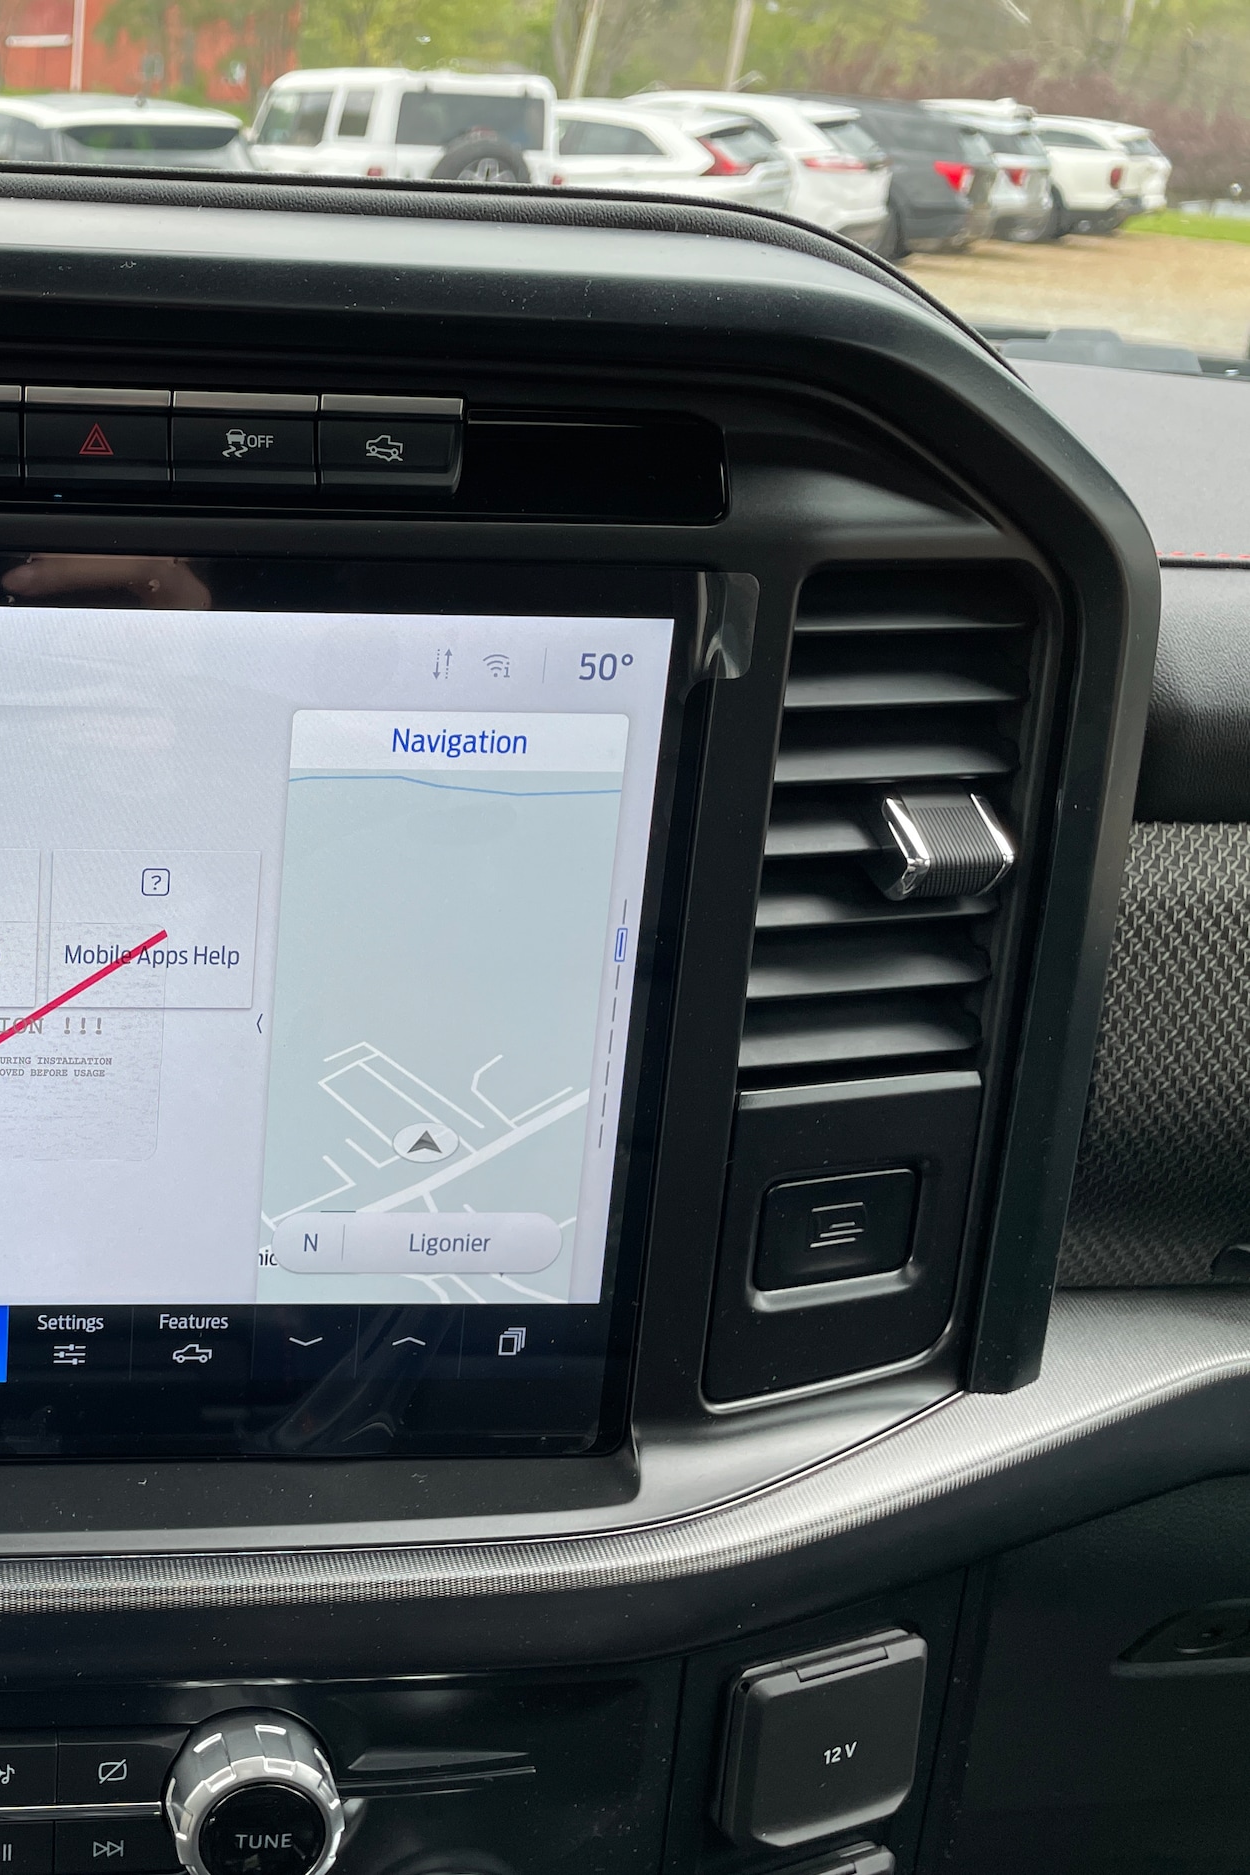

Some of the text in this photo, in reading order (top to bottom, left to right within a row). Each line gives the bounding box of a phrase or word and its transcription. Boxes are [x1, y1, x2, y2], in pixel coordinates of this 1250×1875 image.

[247, 434, 274, 448] OFF
[578, 652, 634, 681] 50°
[391, 727, 528, 758] Navigation
[64, 944, 240, 968] Mobile Apps Help
[37, 1057, 112, 1066] INSTALLATION
[30, 1069, 68, 1077] BEFORE
[74, 1069, 106, 1077] USAGE
[303, 1233, 319, 1252] N
[408, 1232, 491, 1258] Ligonier
[37, 1313, 105, 1333] Settings
[158, 1312, 229, 1330] Features
[823, 1741, 858, 1765] 12 V
[235, 1832, 292, 1849] TUNE
